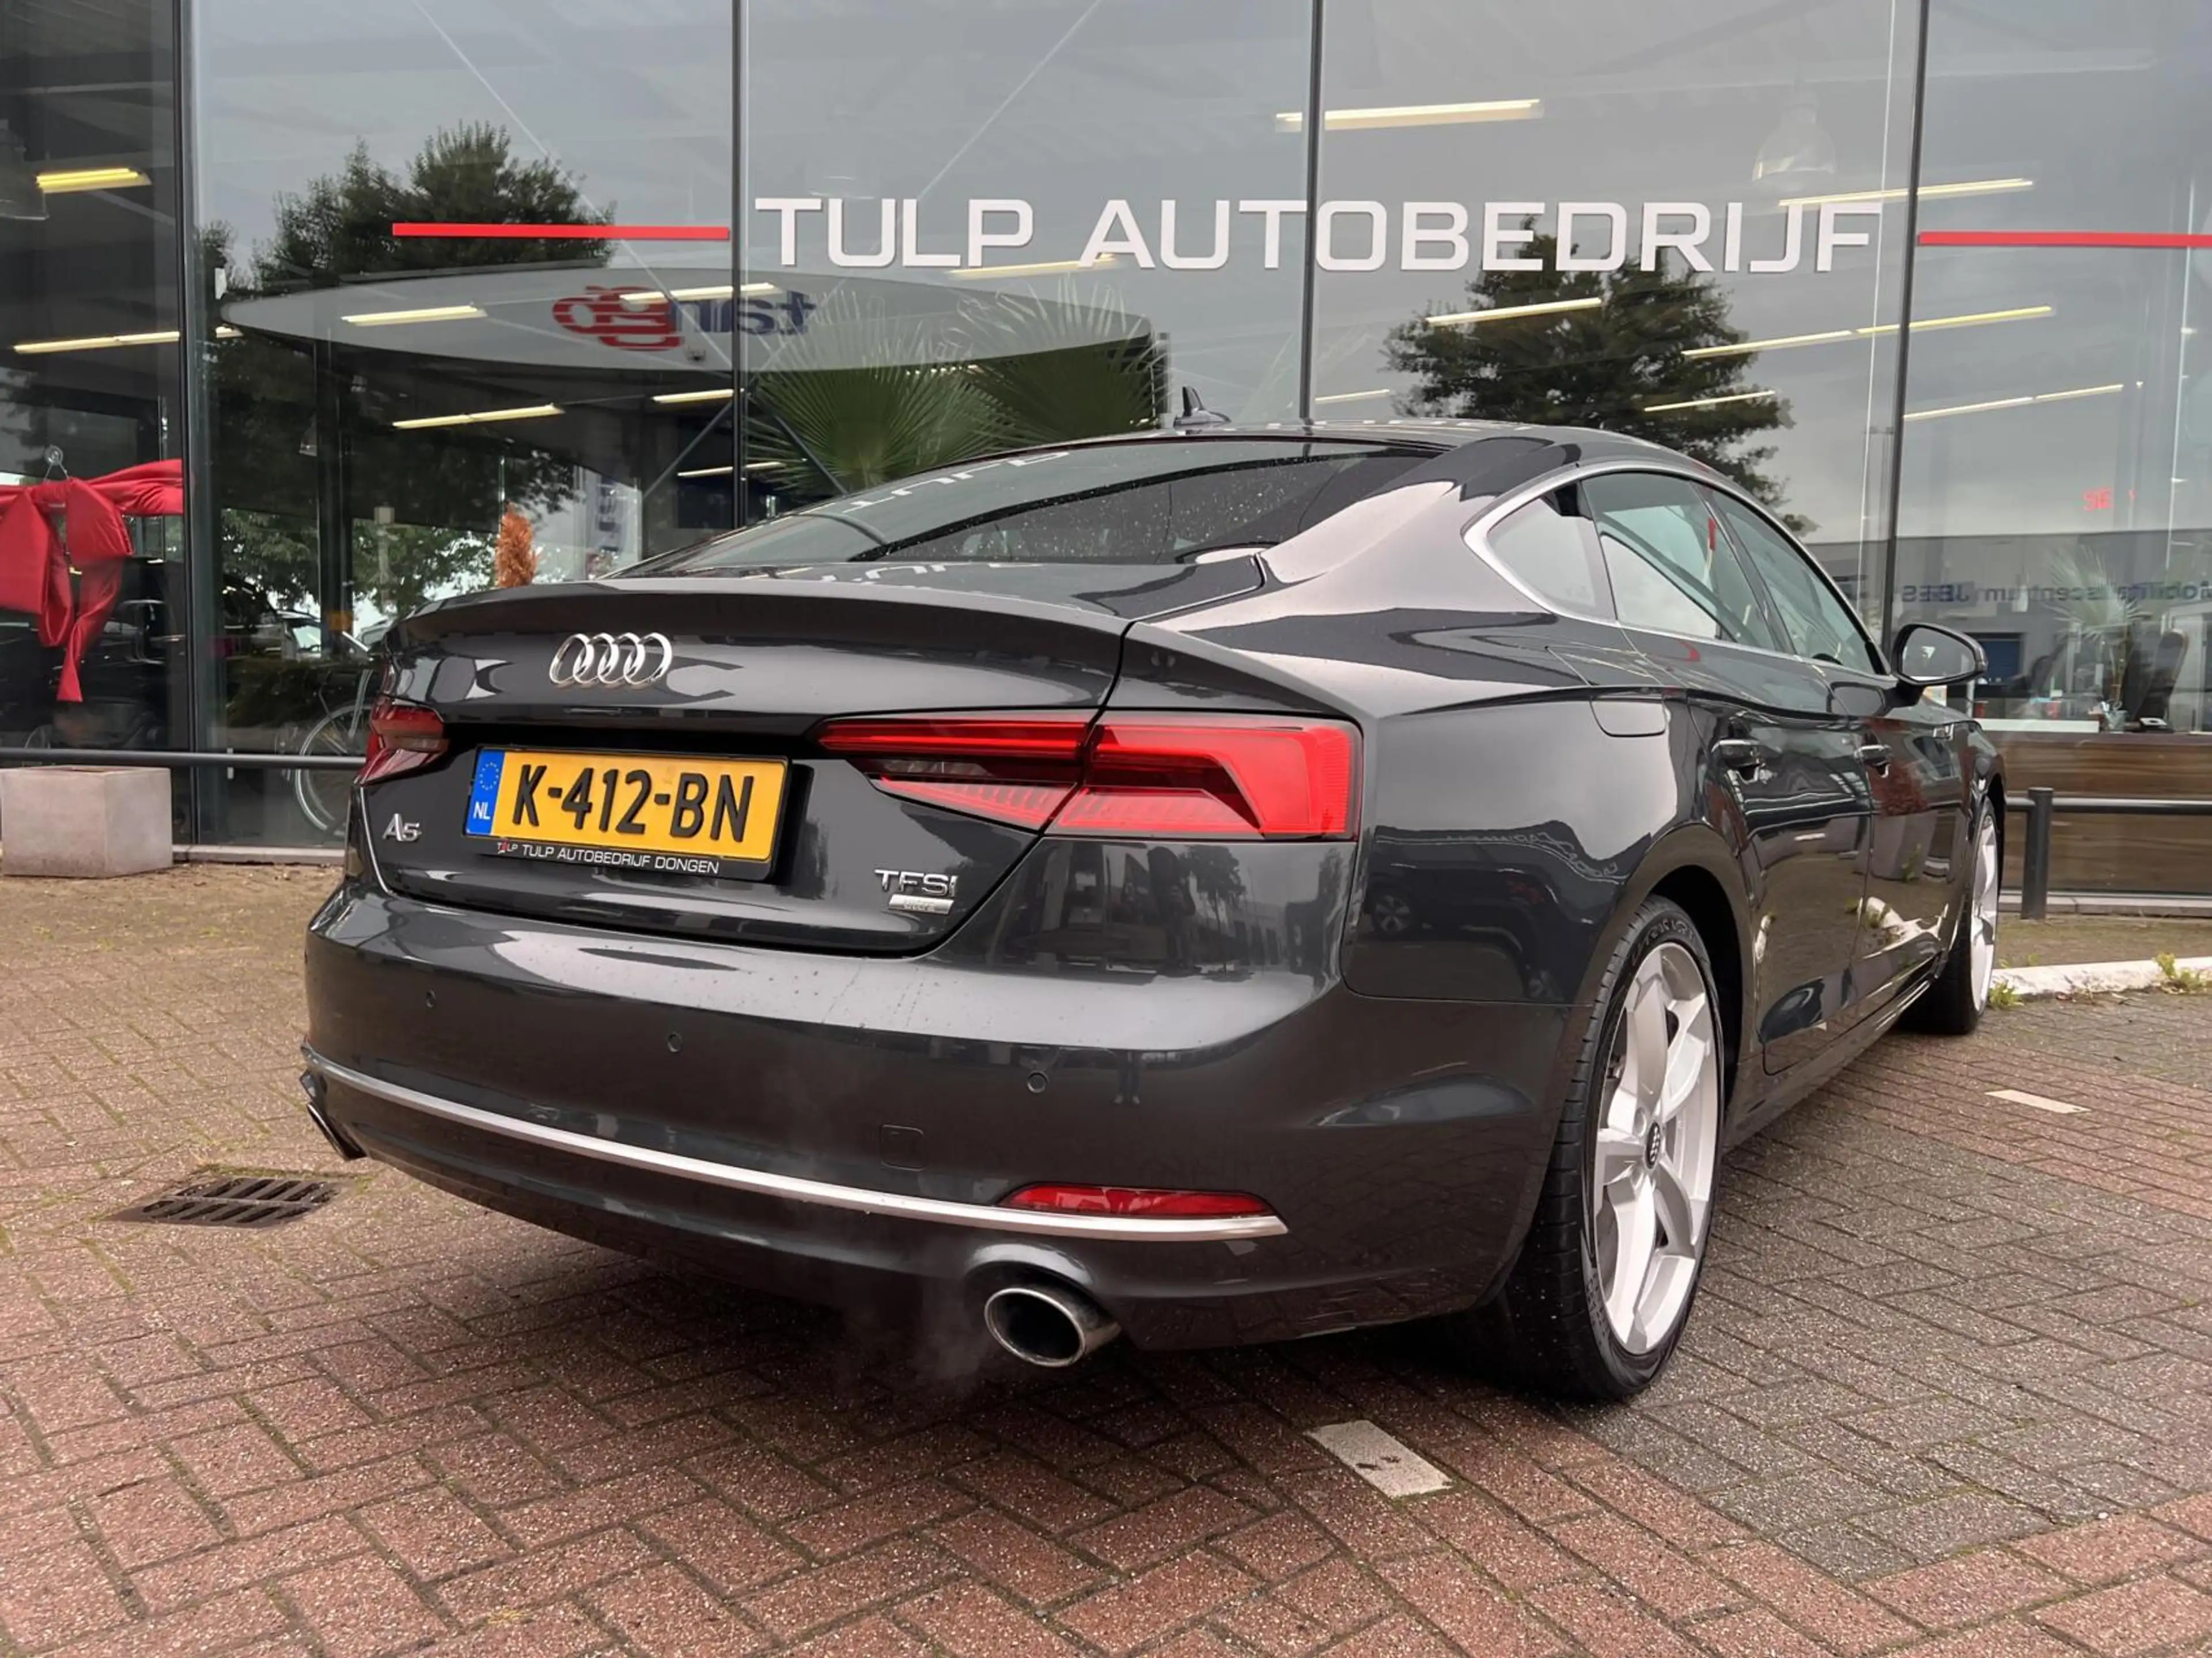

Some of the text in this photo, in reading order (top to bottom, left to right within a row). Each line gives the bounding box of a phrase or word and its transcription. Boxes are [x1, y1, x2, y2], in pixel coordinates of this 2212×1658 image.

[755, 198, 1884, 274] TULP AUTOBEDRIJF
[472, 801, 490, 820] NL
[512, 764, 755, 843] K-412-BN
[381, 813, 422, 841] A5
[521, 844, 719, 874] TULP AUTOBEDRIJF DONGEN
[874, 869, 959, 897] TFSI
